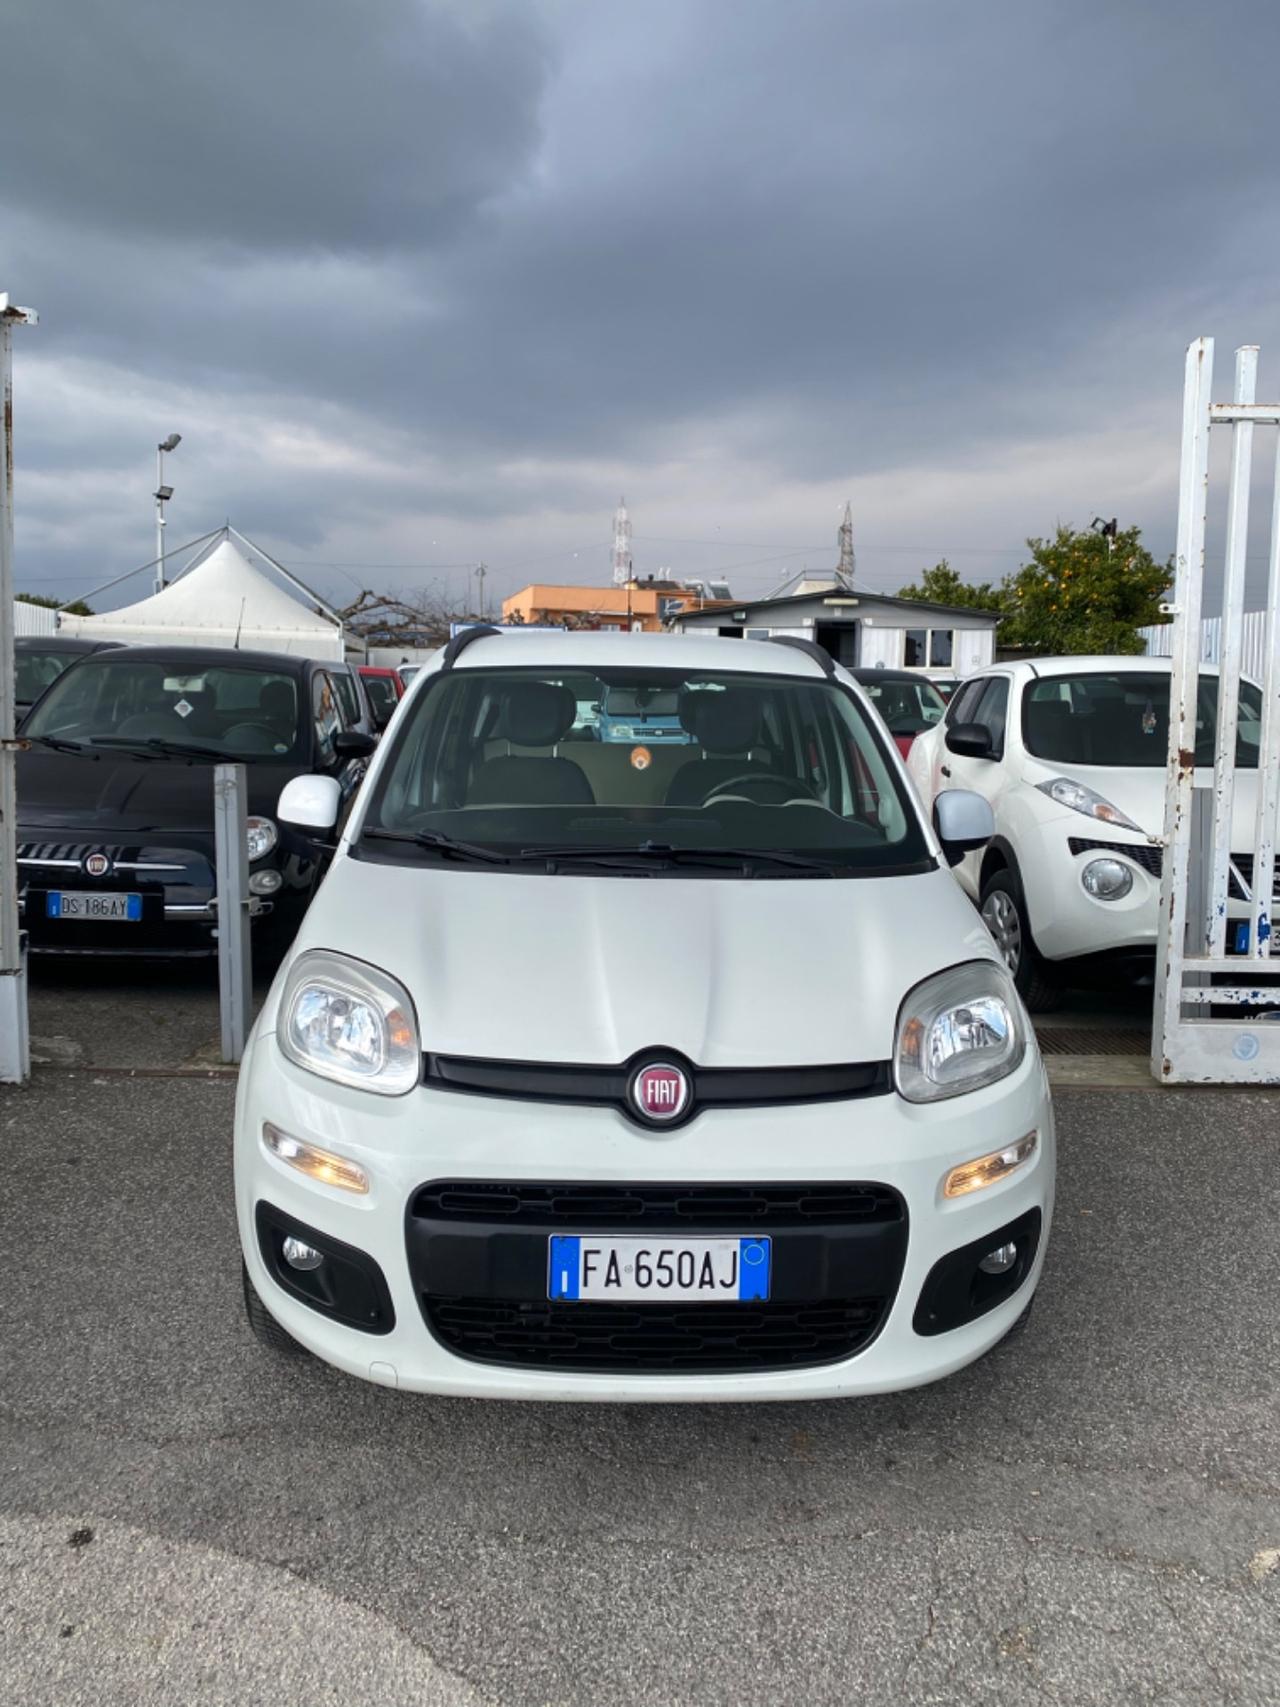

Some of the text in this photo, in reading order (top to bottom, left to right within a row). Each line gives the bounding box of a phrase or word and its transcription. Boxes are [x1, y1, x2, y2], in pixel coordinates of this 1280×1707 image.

[647, 1079, 678, 1104] FIAT
[582, 1249, 738, 1289] FA 650AJ
